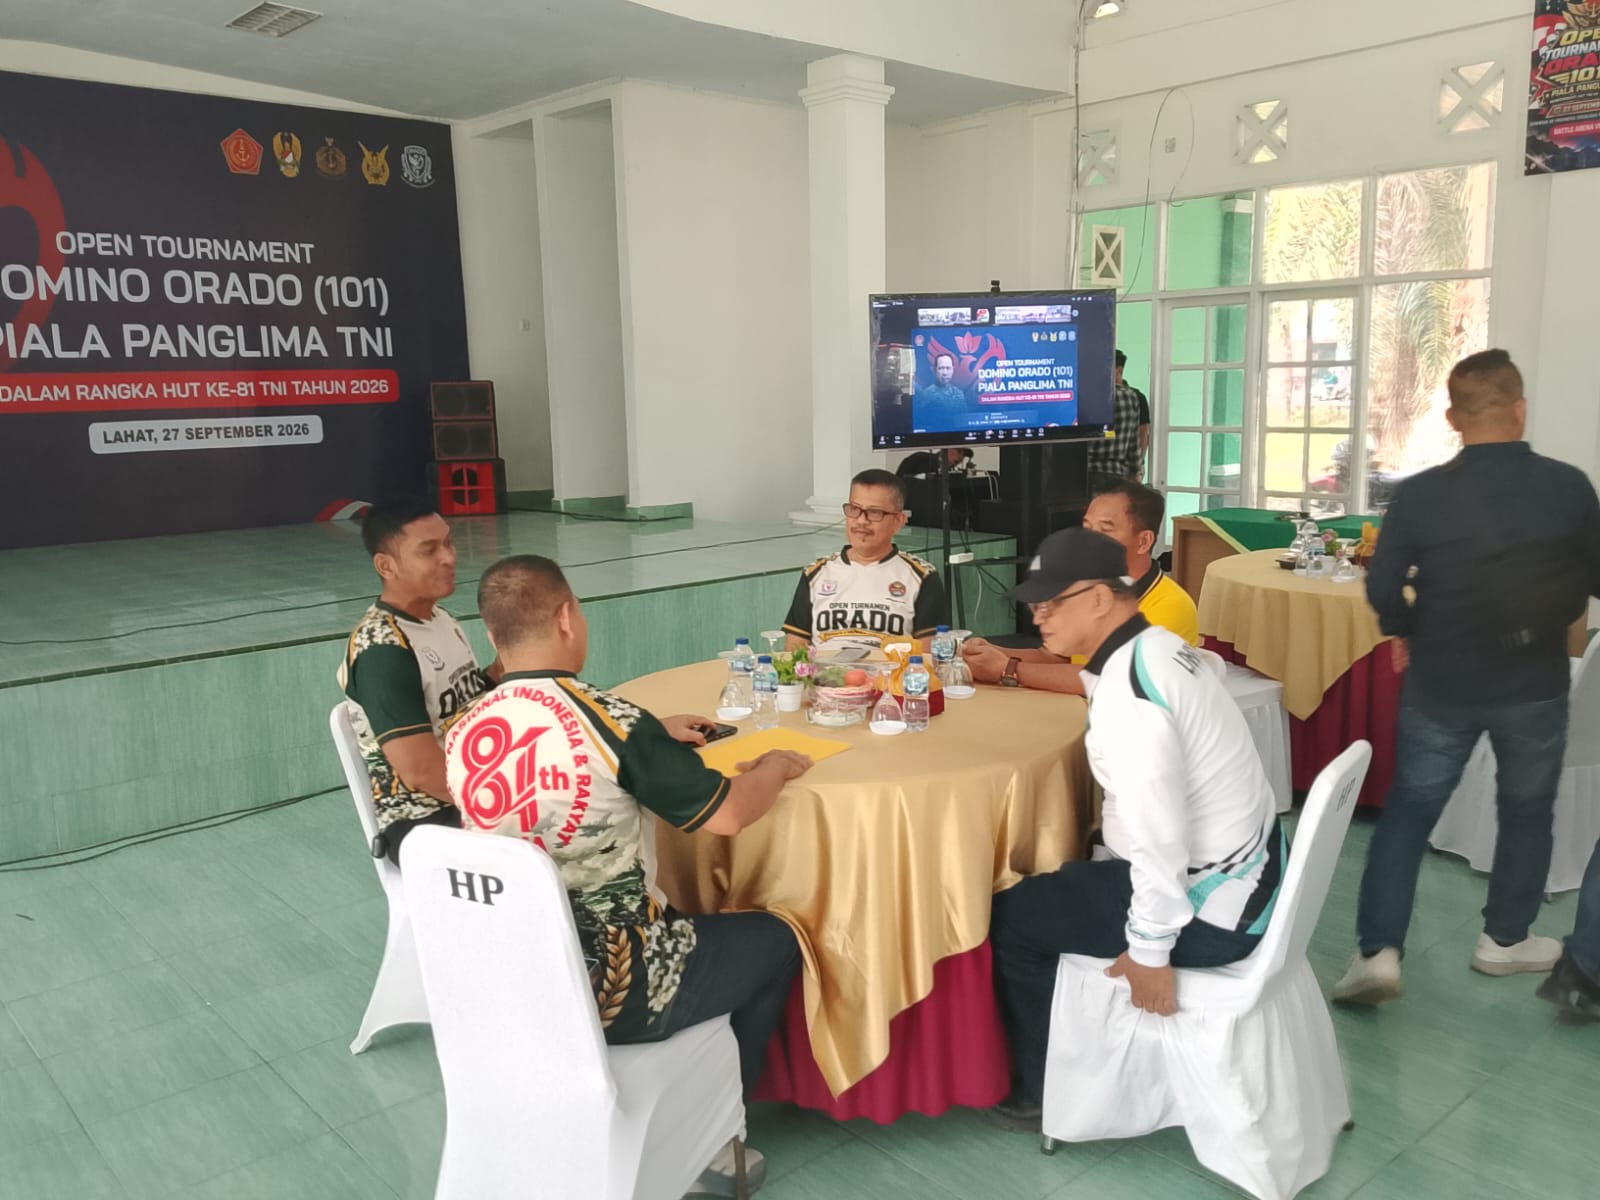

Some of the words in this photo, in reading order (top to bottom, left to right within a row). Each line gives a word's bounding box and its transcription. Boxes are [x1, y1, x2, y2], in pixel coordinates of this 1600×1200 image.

[1545, 40, 1600, 62] TOURNA
[1543, 52, 1600, 77] ORA
[56, 231, 133, 256] OPEN
[140, 234, 314, 264] TOURNAMENT
[0, 264, 150, 303] OMINO
[163, 270, 303, 306] ORADO
[314, 275, 389, 316] (101)
[122, 324, 329, 358] PANGLIMA
[336, 326, 393, 357] TNI
[978, 368, 1016, 379] DOMINO
[1018, 366, 1051, 377] ORADO
[1053, 366, 1073, 378] (101)
[978, 381, 1006, 392] PIALA
[1008, 380, 1056, 391] PANGLIMA
[1058, 378, 1073, 389] TNI
[0, 384, 70, 402] DALAM
[76, 383, 157, 400] RANGKA
[163, 382, 200, 398] HUT
[206, 381, 255, 397] KE-81
[259, 381, 287, 396] TNI
[291, 380, 346, 396] TAHUN
[350, 379, 389, 394] 2026
[103, 429, 158, 445] LAHAT,
[162, 428, 180, 442] 27
[185, 424, 273, 441] SEPTEMBER
[277, 423, 310, 437] 2026
[829, 602, 849, 610] OPEN
[850, 602, 890, 612] TURNAMEN
[816, 609, 905, 637] ORADO
[446, 688, 508, 755] NASIONAL
[513, 686, 585, 750] INDONESIA
[572, 754, 589, 769] &
[556, 773, 592, 847] RAKYAT
[446, 867, 504, 906] HP
